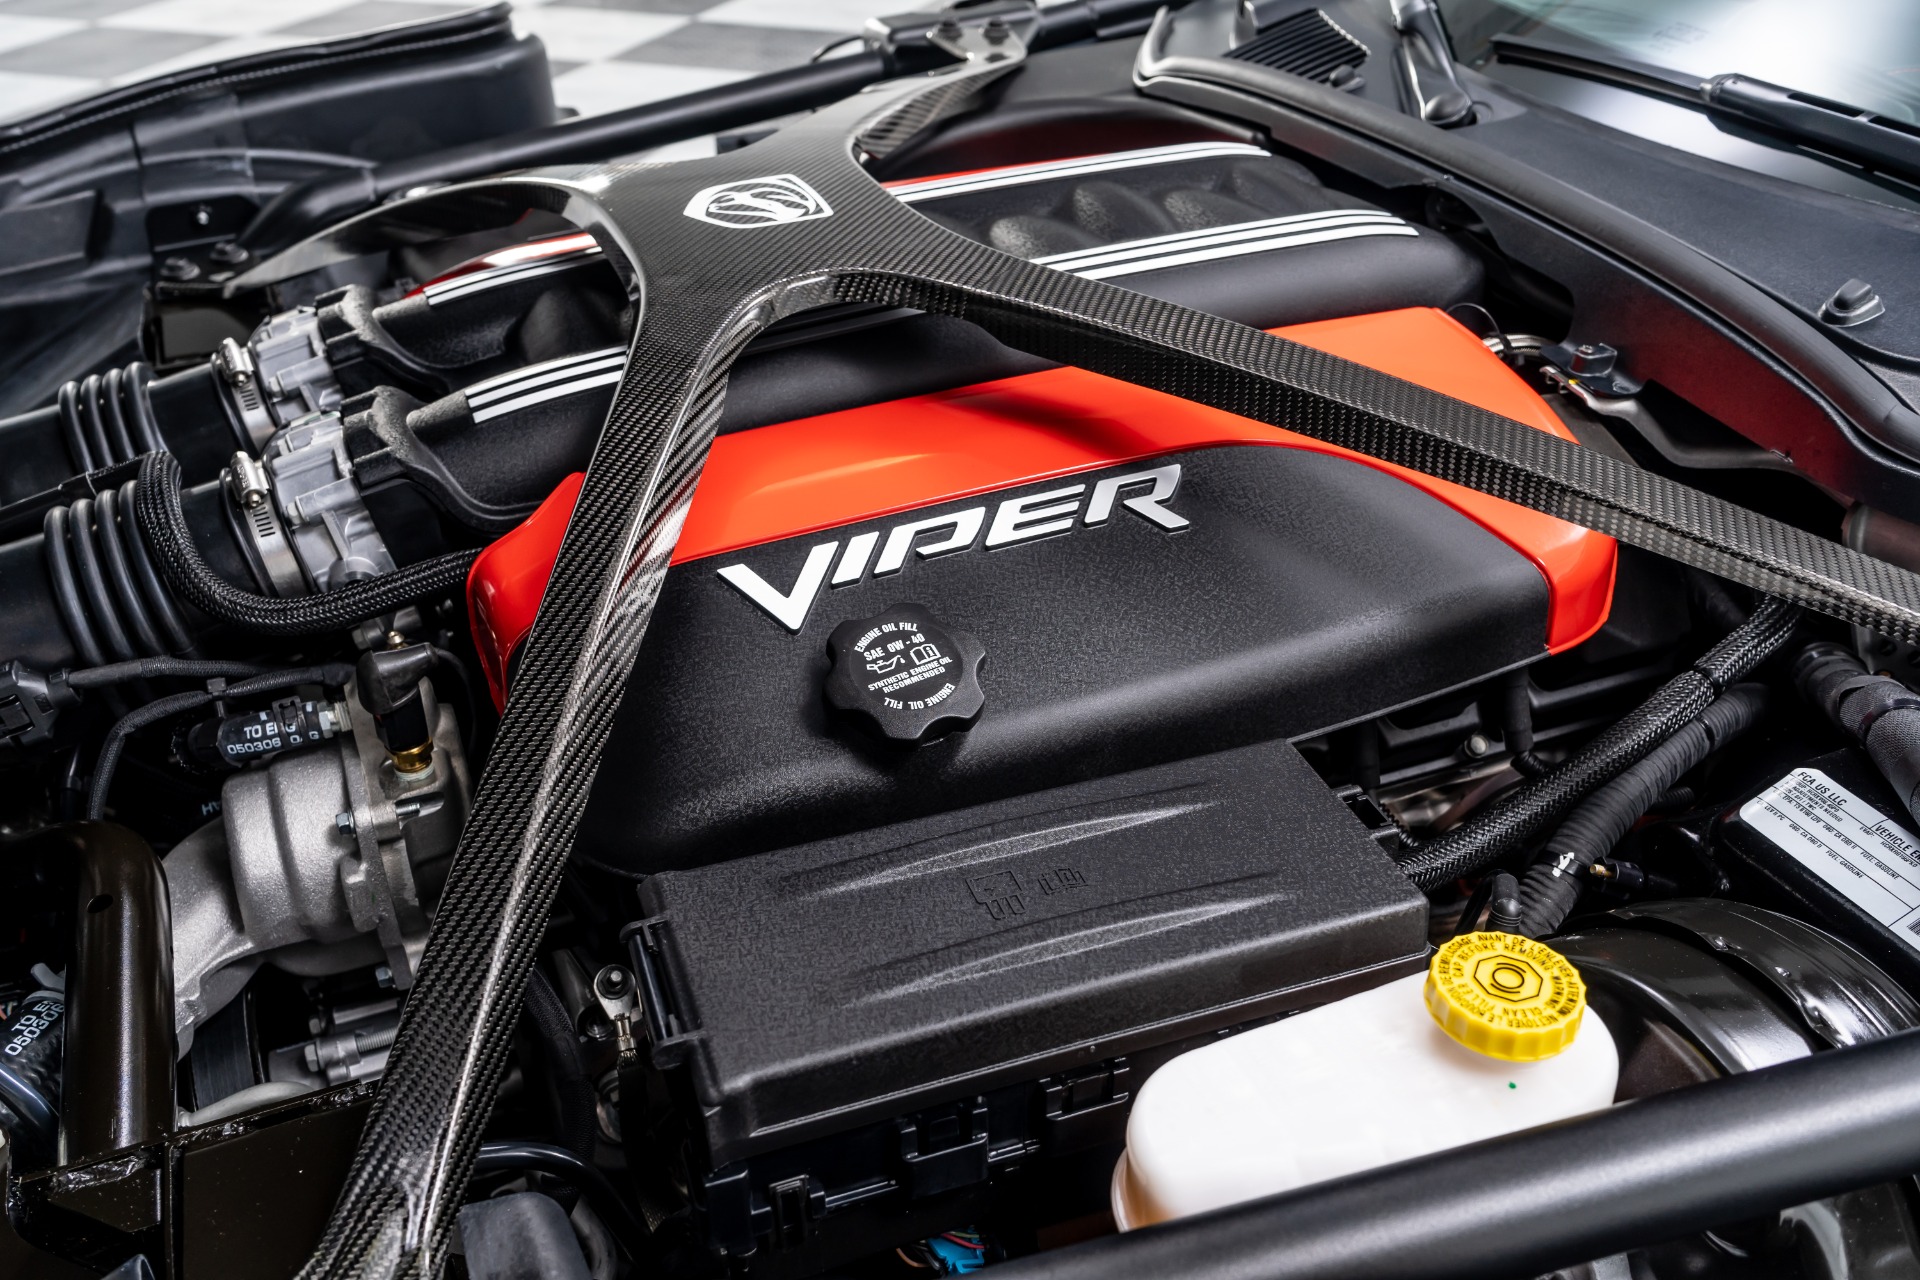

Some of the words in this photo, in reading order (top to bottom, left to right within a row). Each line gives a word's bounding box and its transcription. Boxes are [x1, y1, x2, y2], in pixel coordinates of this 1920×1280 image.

[716, 463, 1190, 635] VIPER
[854, 627, 882, 652] ENGINE
[881, 623, 898, 632] OIL
[899, 622, 918, 632] FILL
[863, 647, 885, 661] SAE
[886, 640, 905, 653] 0W
[911, 633, 925, 644] 40
[868, 671, 909, 691] SYNTHETIC
[910, 660, 940, 676] ENGINE
[939, 656, 953, 666] OIL
[882, 666, 946, 693] RECOMMENDED
[884, 697, 903, 709] FILL
[908, 700, 924, 710] OIL
[924, 682, 956, 707] ENGINE
[244, 725, 262, 739] TO
[1798, 771, 1816, 785] FCA
[1815, 783, 1830, 794] US
[1828, 793, 1847, 806] LLC
[1792, 786, 1825, 810] ADJUSTMENTS
[1823, 807, 1843, 823] NEEDED
[1875, 825, 1912, 852] VEHICLE
[1840, 860, 1864, 878] GASOLINE
[1874, 861, 1900, 880] GASOLINE
[1457, 942, 1497, 961] BEFORE
[1477, 934, 1507, 943] AVANT
[1512, 936, 1526, 947] DE
[1504, 943, 1554, 971] REMOVING
[1452, 961, 1464, 977] CAP
[11, 1014, 37, 1032] TO
[1503, 1007, 1542, 1018] CLEAN
